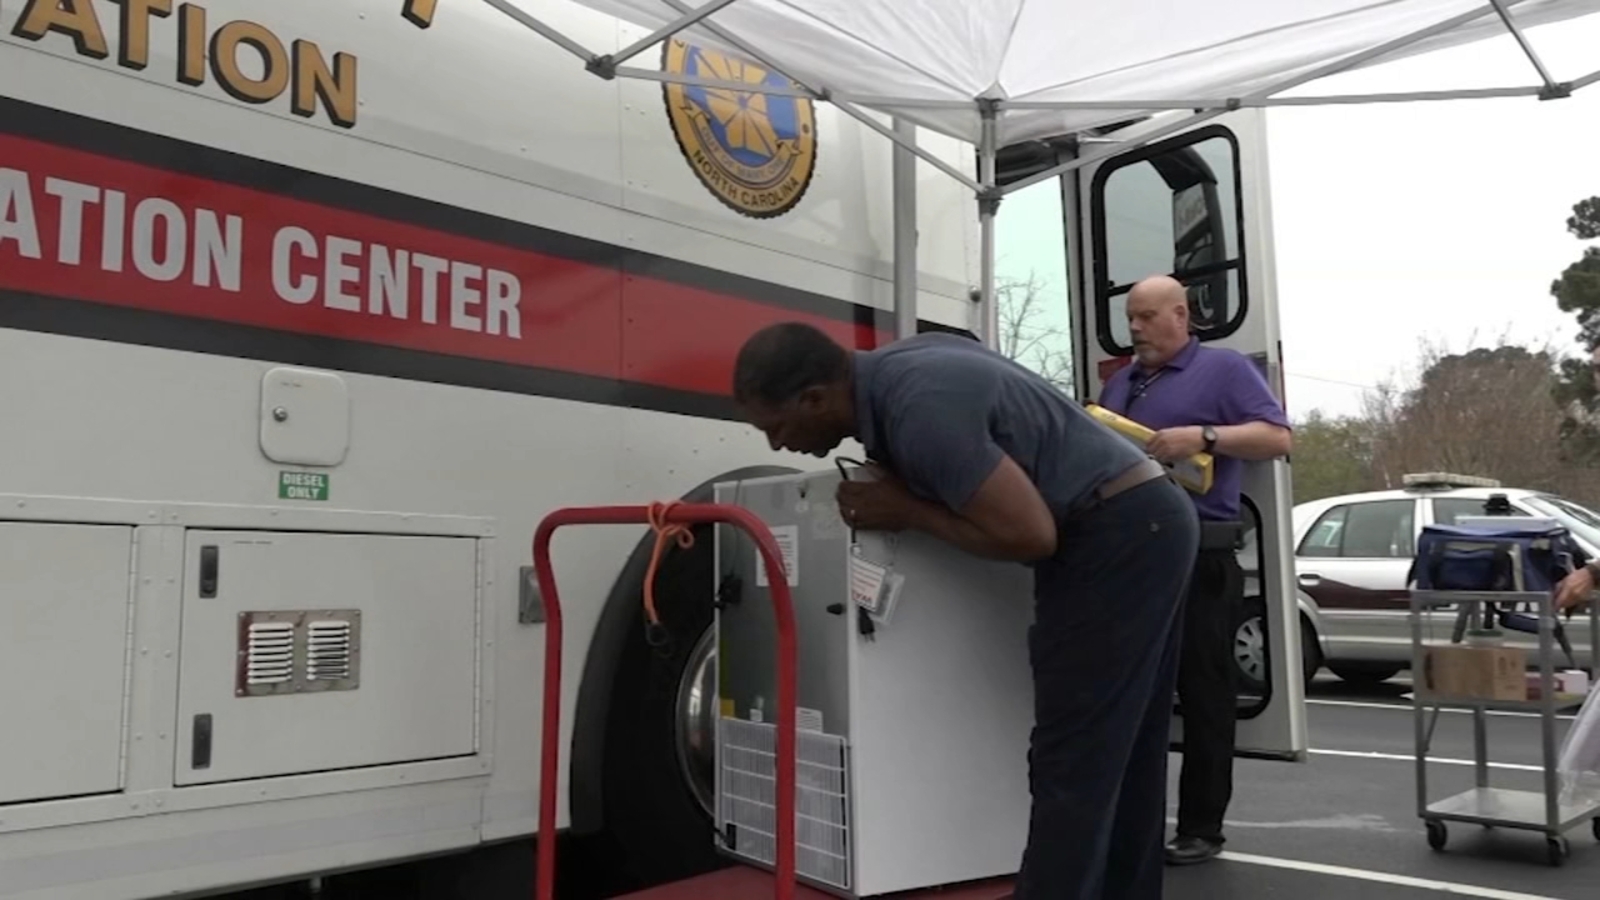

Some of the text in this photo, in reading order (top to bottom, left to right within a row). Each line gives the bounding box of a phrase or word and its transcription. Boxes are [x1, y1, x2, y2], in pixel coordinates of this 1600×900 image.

[693, 150, 737, 199] NORTH
[741, 176, 799, 207] CAROLINA
[0, 166, 522, 340] ATION CENTER
[282, 473, 325, 487] DIESEL
[287, 486, 321, 499] ONLY
